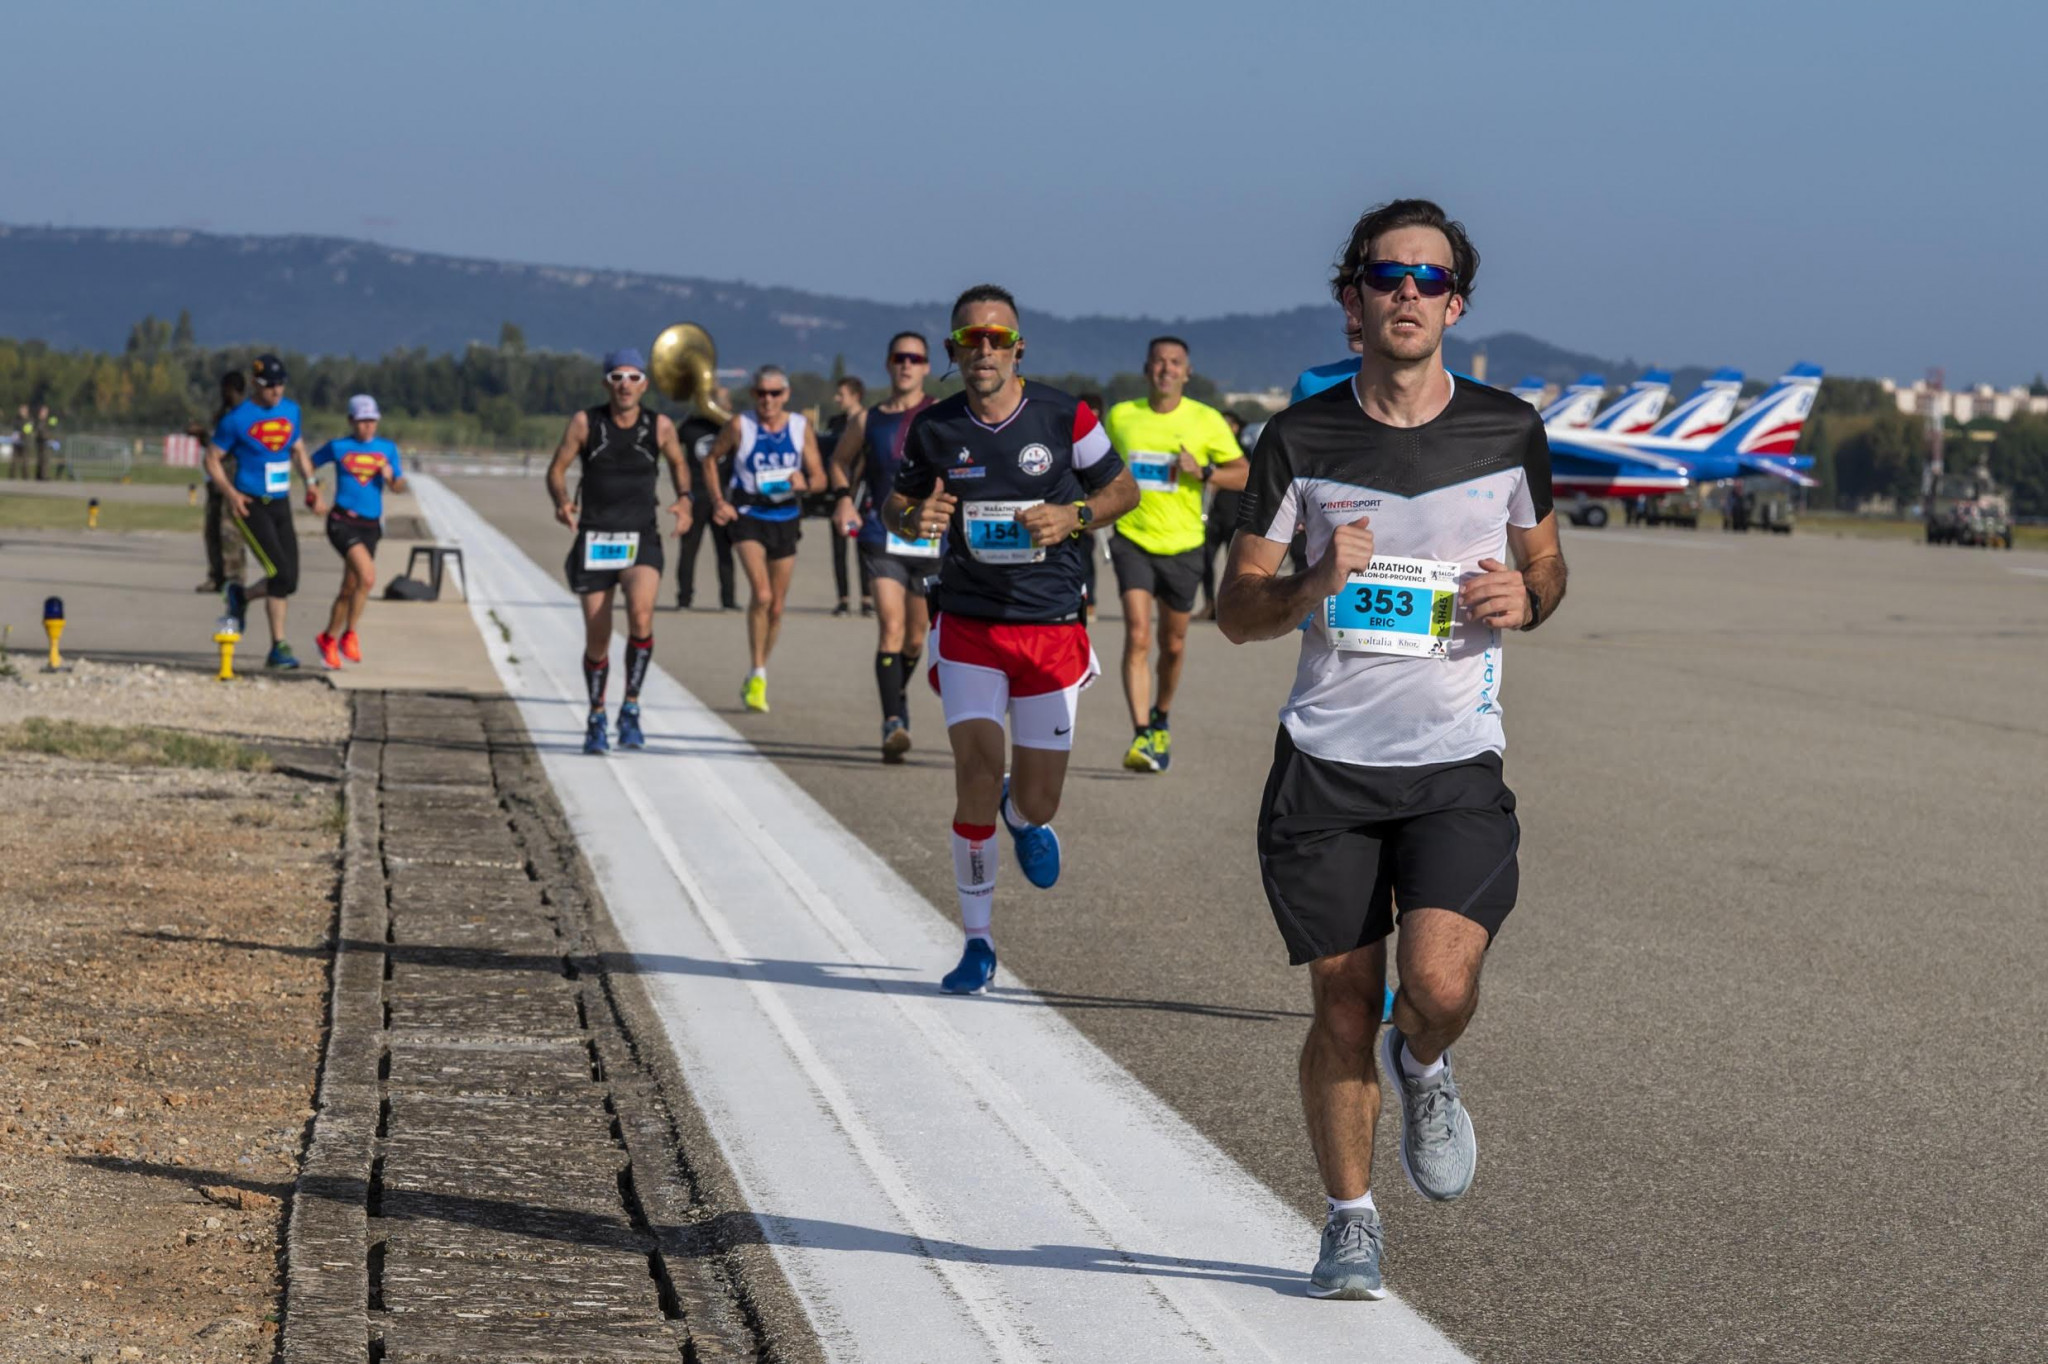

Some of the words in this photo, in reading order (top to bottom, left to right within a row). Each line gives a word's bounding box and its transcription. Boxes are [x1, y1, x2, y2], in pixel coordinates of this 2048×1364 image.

[1327, 500, 1382, 509] INTERSPORT
[983, 523, 1019, 539] 154
[1354, 587, 1414, 617] 353
[1369, 616, 1396, 628] ERIC
[1357, 637, 1392, 647] voltalia
